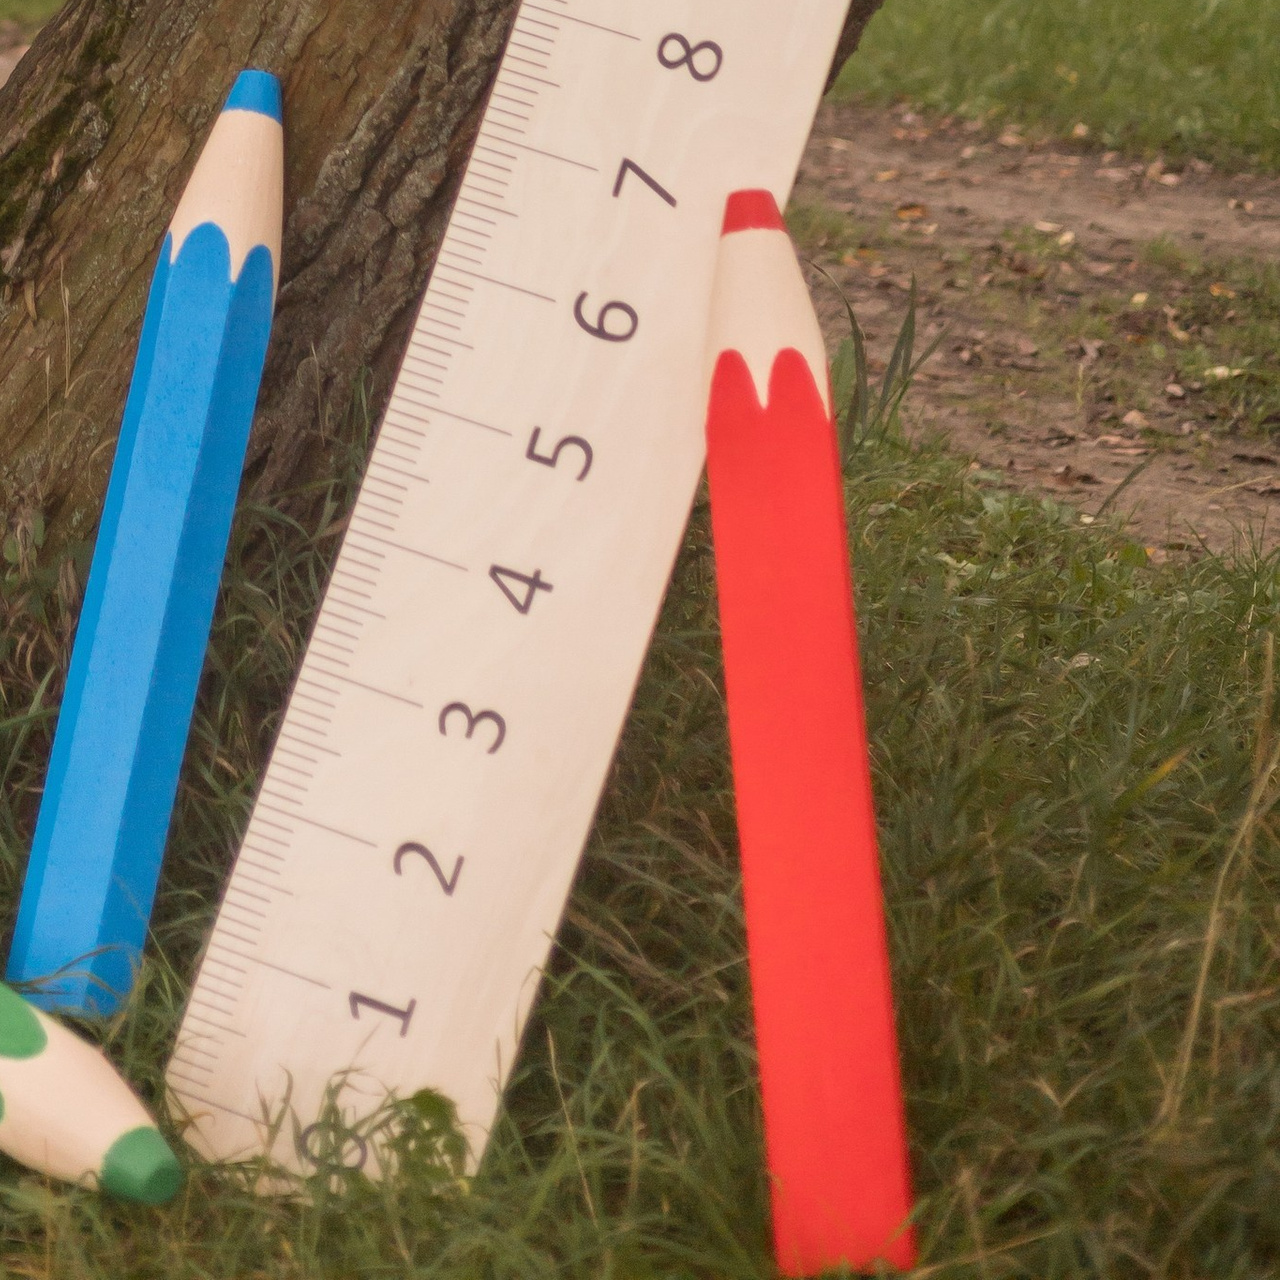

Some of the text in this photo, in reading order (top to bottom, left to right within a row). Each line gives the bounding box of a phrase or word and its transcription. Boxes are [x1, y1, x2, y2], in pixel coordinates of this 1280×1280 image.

[348, 990, 417, 1037] 1
[393, 840, 465, 896] 2
[438, 701, 507, 755] 3
[488, 563, 554, 615] 4
[525, 426, 594, 482] 5
[573, 291, 639, 343] 6
[612, 157, 677, 208] 7
[656, 32, 724, 83] 8
